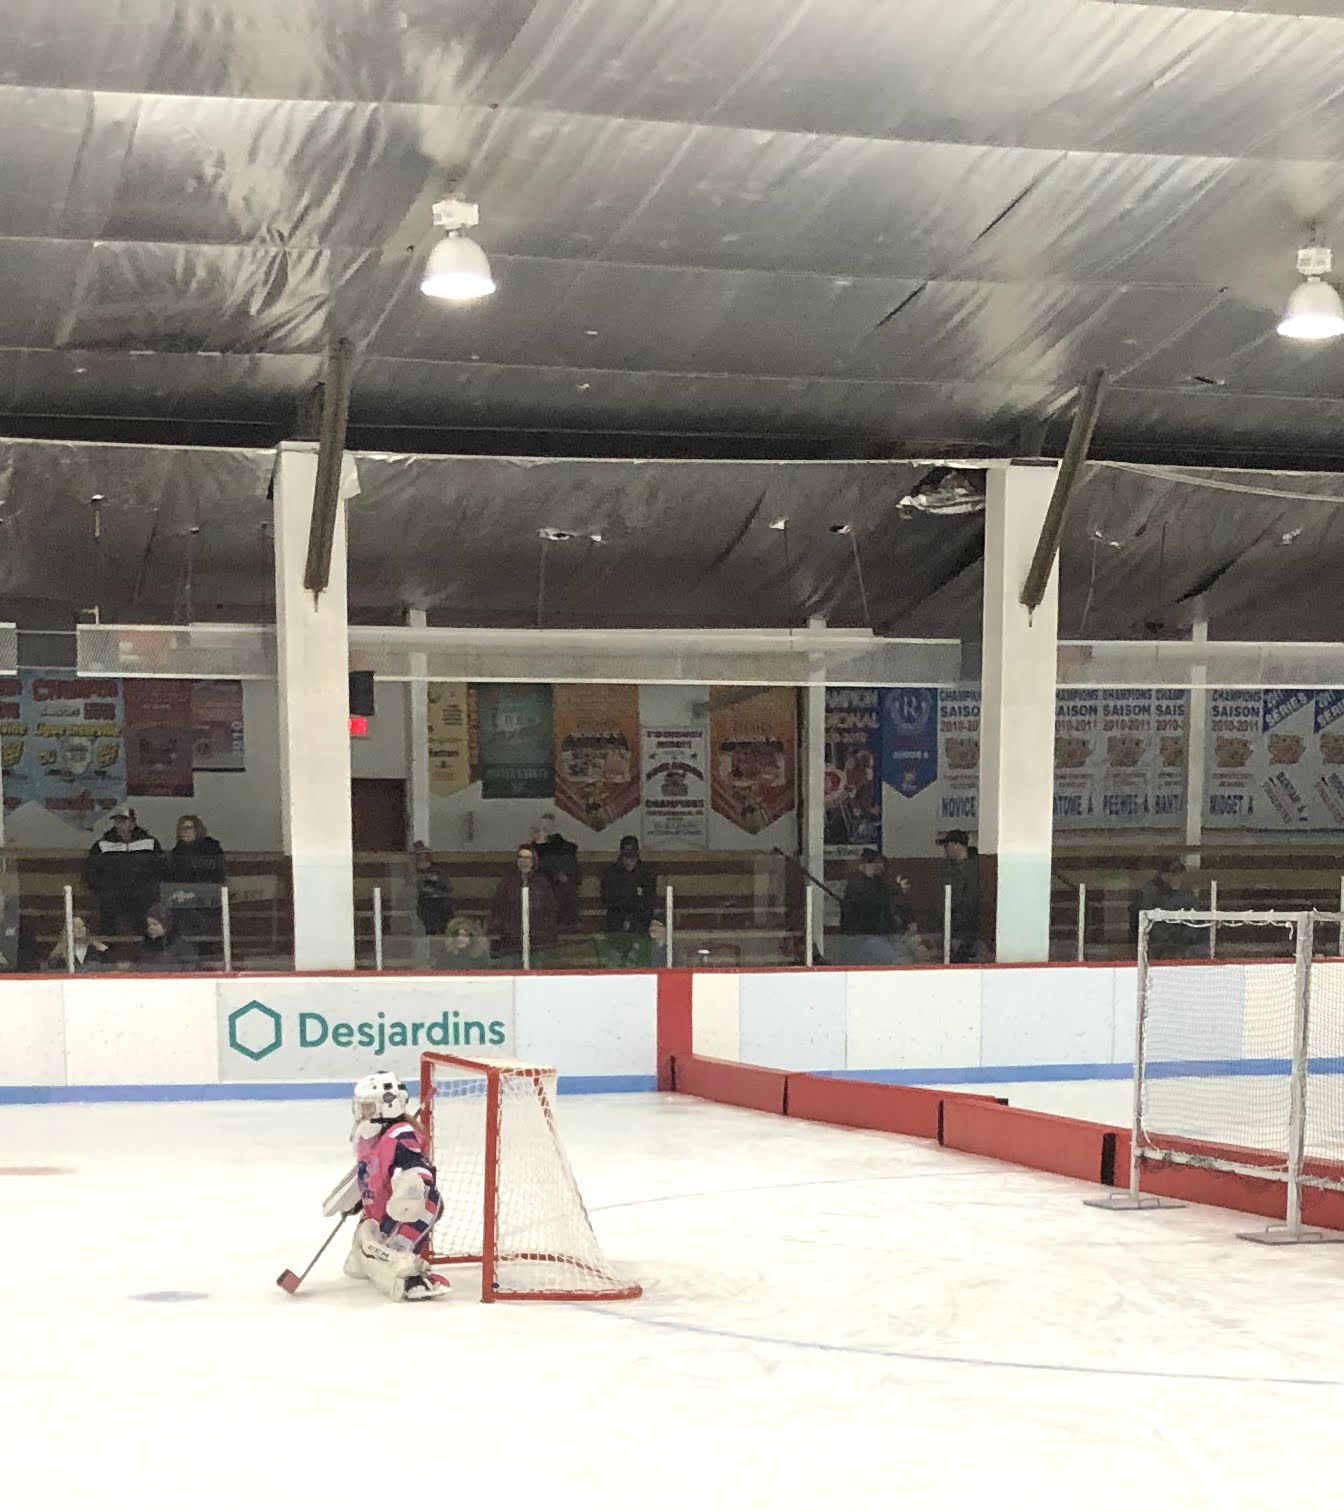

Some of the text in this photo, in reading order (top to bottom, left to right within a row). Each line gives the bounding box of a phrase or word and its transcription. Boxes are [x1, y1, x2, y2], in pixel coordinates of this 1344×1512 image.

[1156, 688, 1185, 700] CHAMP
[940, 705, 980, 717] SAISO
[1056, 704, 1098, 717] AISON
[1103, 704, 1152, 717] SAISON
[1156, 704, 1185, 717] SAIS
[1212, 705, 1261, 718] SAISON
[298, 1010, 506, 1056] Desjardins
